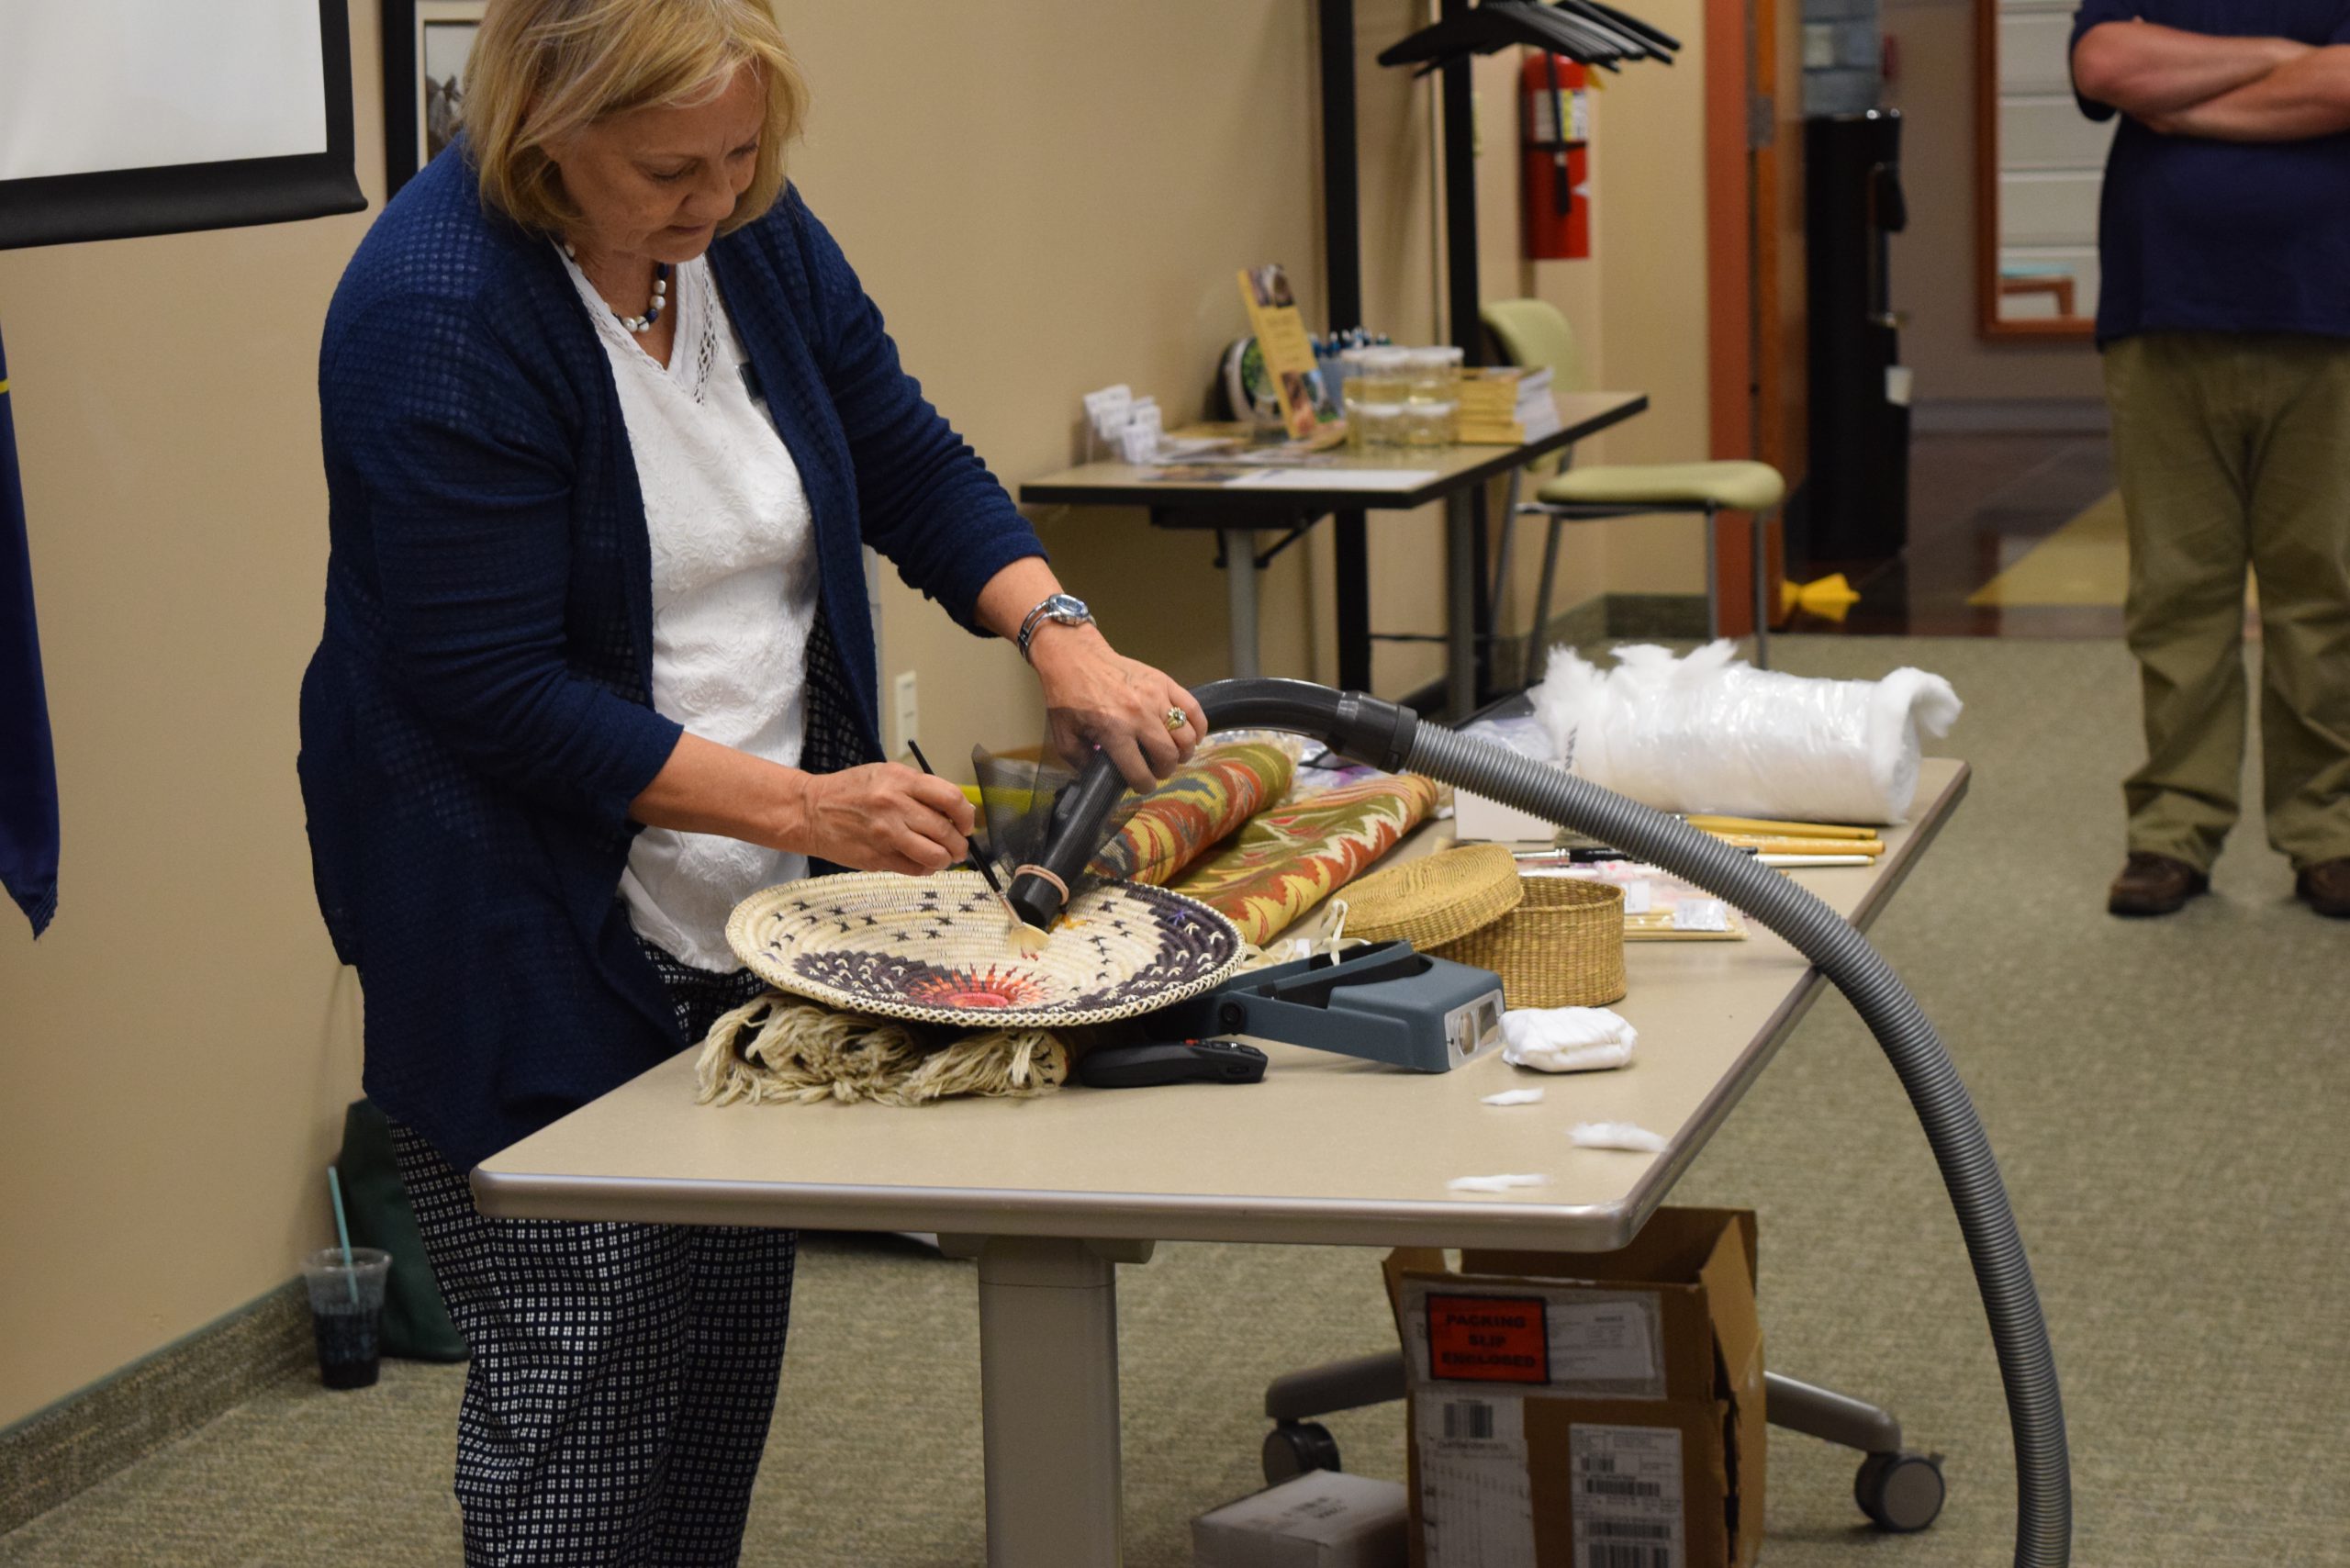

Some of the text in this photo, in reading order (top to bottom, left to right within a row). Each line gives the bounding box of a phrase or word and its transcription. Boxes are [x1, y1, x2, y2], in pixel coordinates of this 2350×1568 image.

[1447, 1315, 1525, 1327] PACKING
[1470, 1335, 1505, 1347] SLIP
[1442, 1352, 1535, 1367] ENCLOSED
